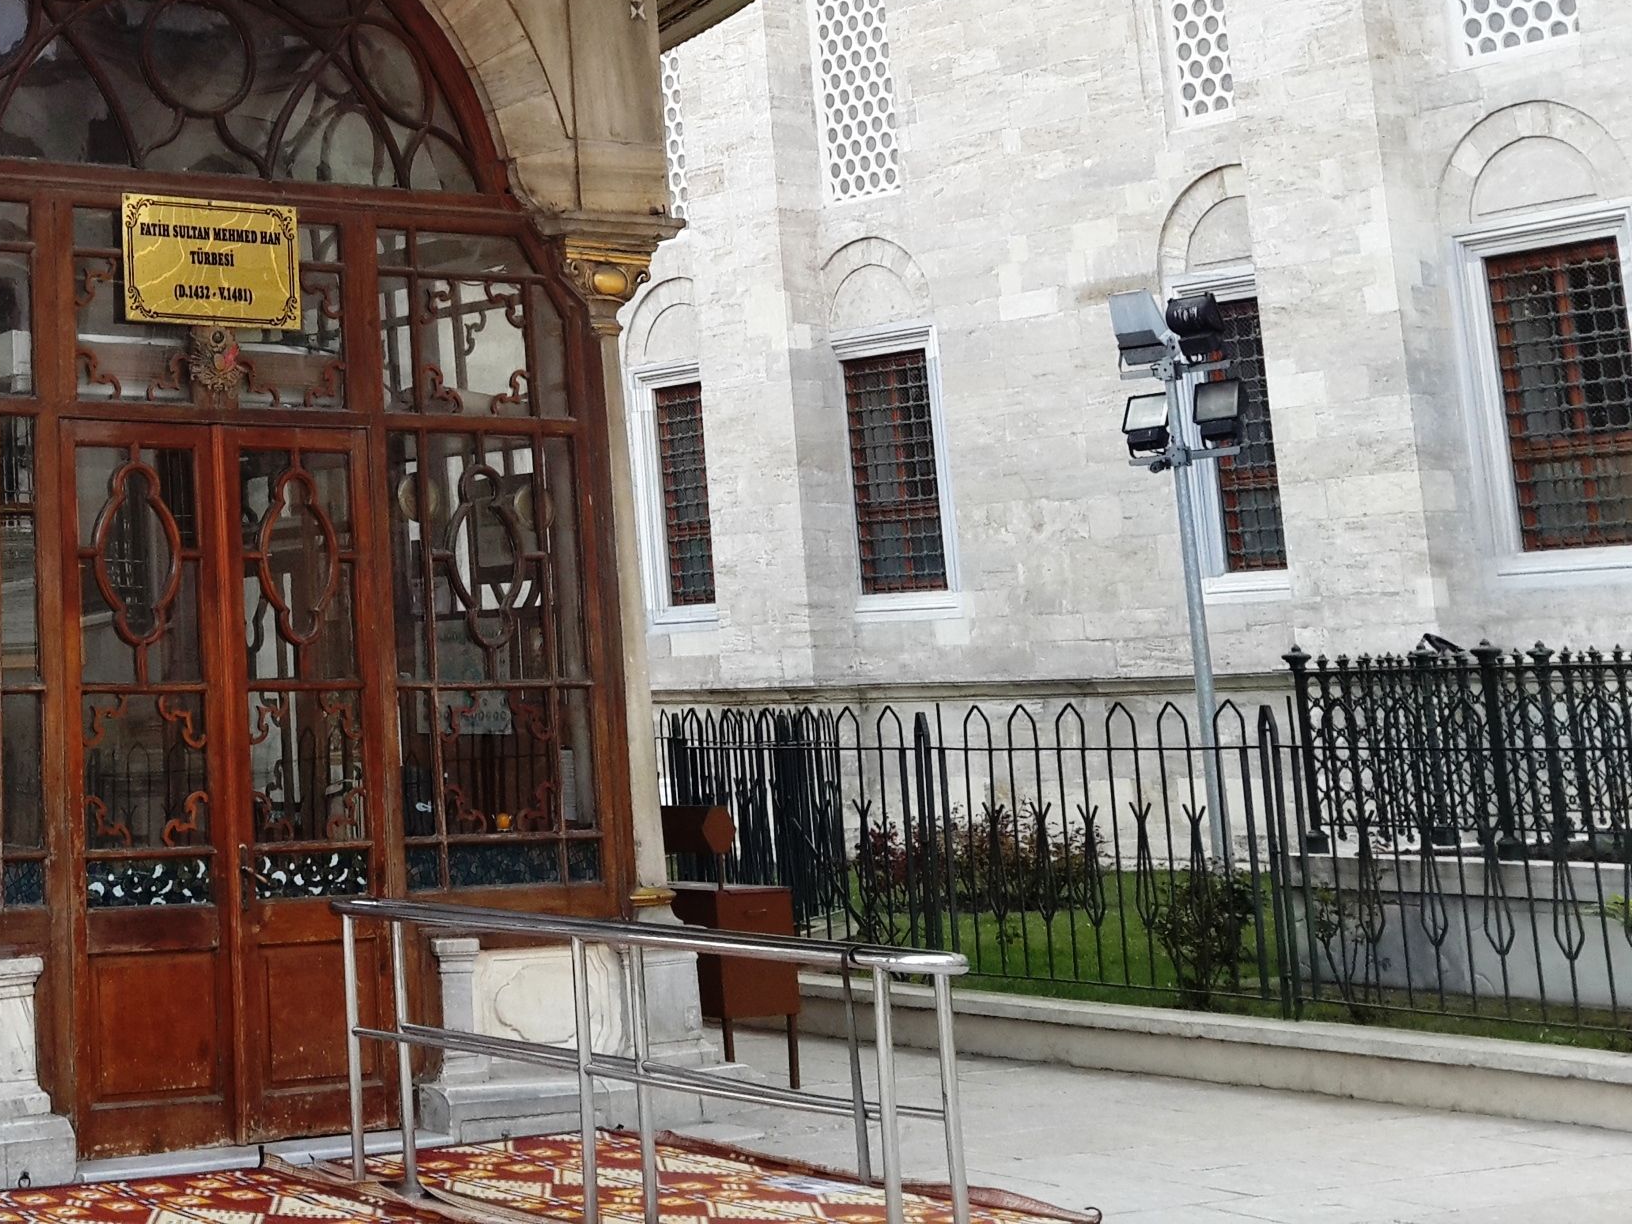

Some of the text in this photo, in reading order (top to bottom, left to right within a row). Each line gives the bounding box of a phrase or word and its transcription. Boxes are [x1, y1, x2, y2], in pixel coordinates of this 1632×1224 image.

[140, 219, 281, 245] FATİH SULTAN MEHMED HAN
[189, 247, 235, 267] TÜRBESİ
[174, 284, 210, 300] (D.1432
[218, 287, 253, 305] V.1481)
